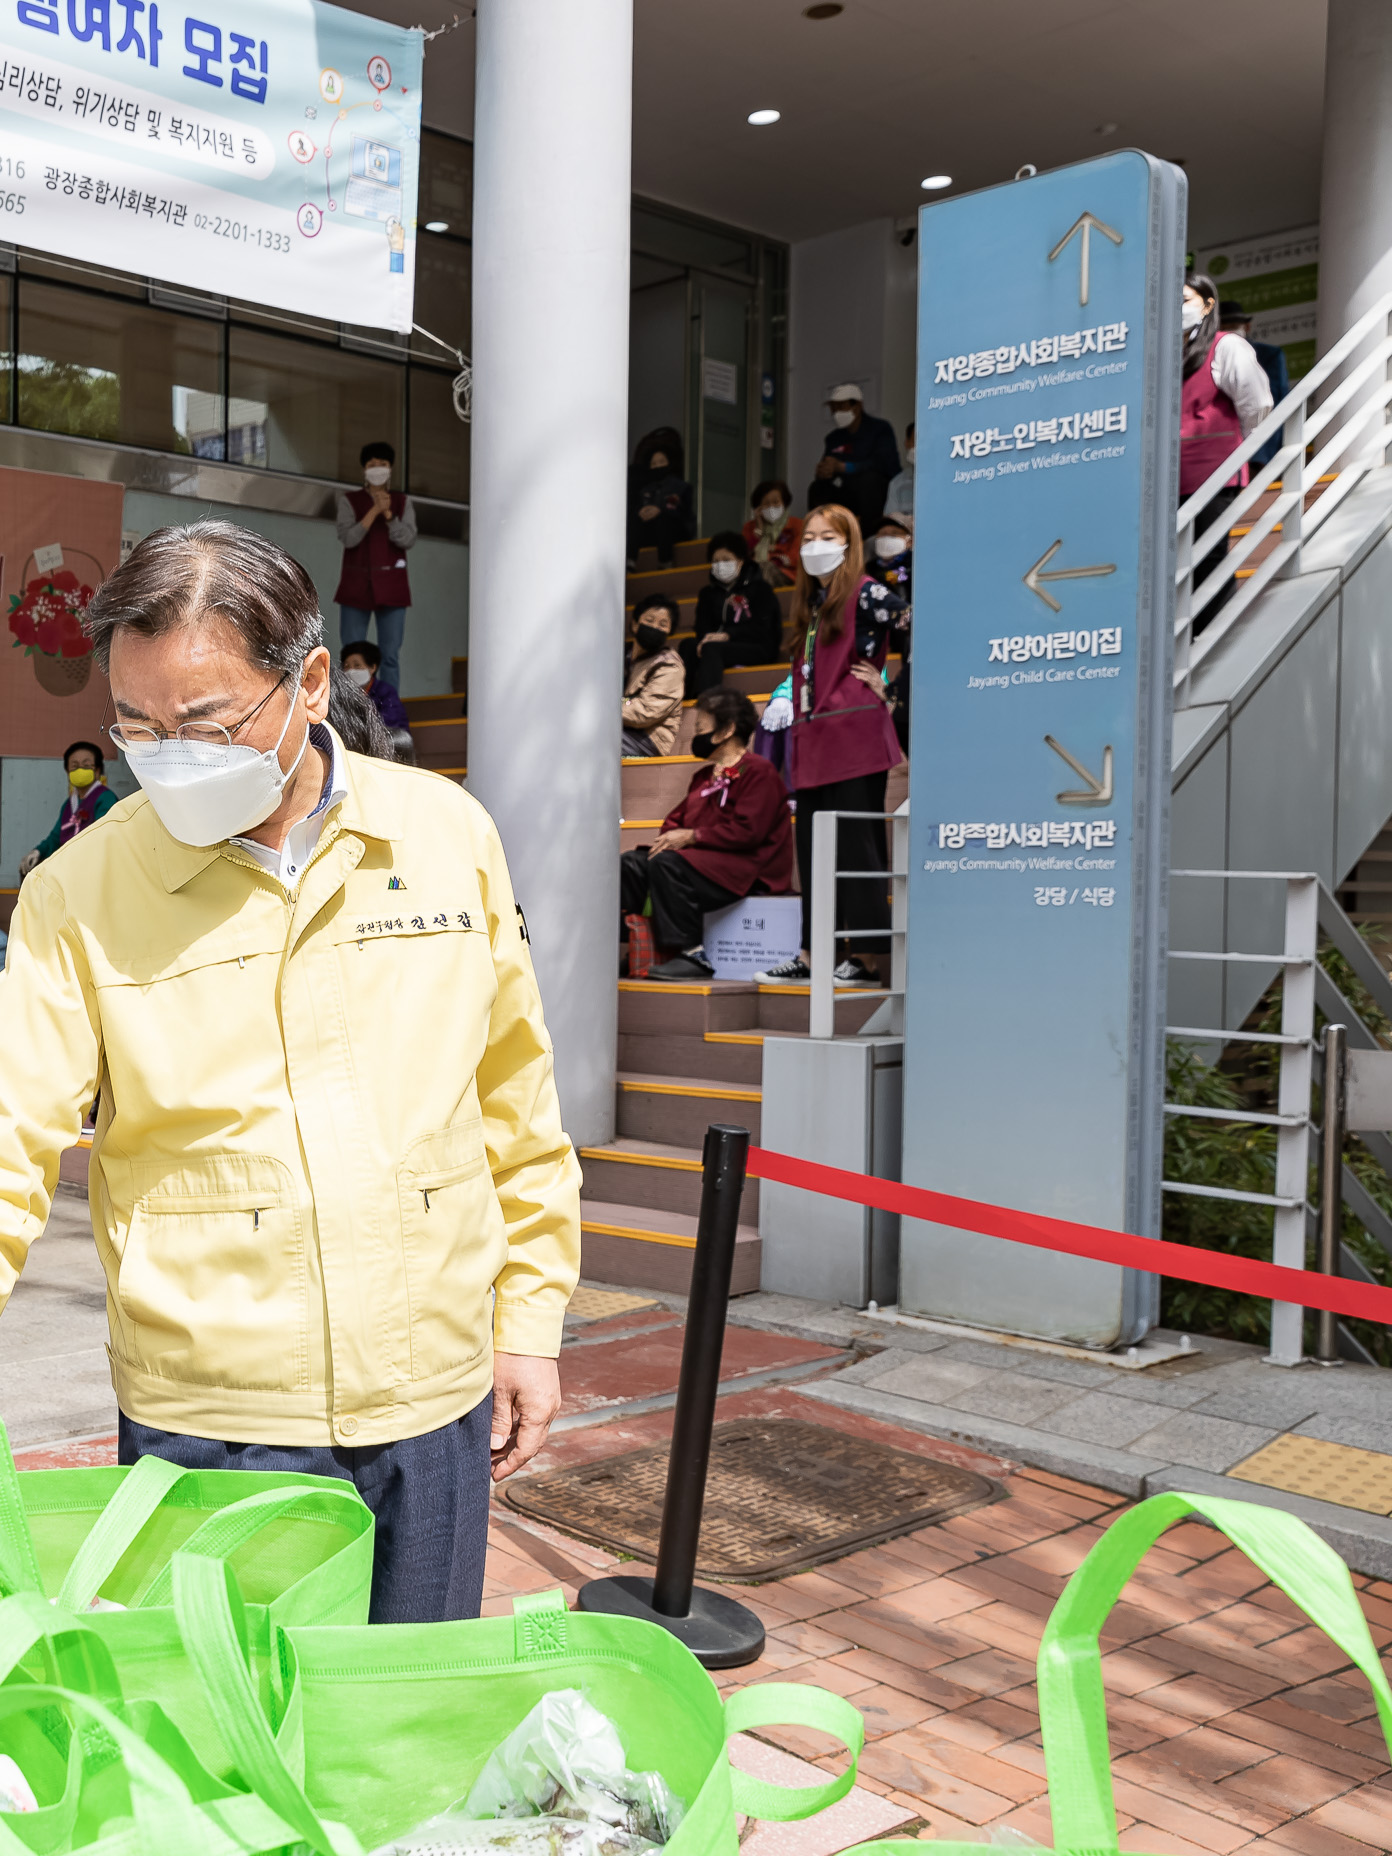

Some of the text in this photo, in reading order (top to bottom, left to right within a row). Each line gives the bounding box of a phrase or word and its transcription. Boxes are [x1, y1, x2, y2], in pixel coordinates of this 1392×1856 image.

[182, 17, 268, 104] 모집
[72, 87, 140, 132] 위기상담
[147, 109, 160, 140] 및
[169, 116, 234, 158] 복지지원
[242, 138, 257, 164] 등
[43, 166, 188, 228] 광장종합사회복지관
[194, 213, 291, 254] 02-2201-1333
[934, 321, 1129, 385] 자양종합사회복지관
[928, 360, 1129, 411] Jayang Community Welfare Center
[950, 404, 1128, 460] 자양노인복지센터
[952, 445, 1126, 484] Jayang Silver Welfare Center
[988, 627, 1122, 664] 자양어린이집
[967, 665, 1121, 690] Jayang Child Care Center
[958, 857, 1027, 873] Community
[1028, 857, 1074, 871] Welfare
[1075, 857, 1117, 870] Center
[1033, 887, 1067, 906] 강당
[1081, 887, 1116, 906] 식당
